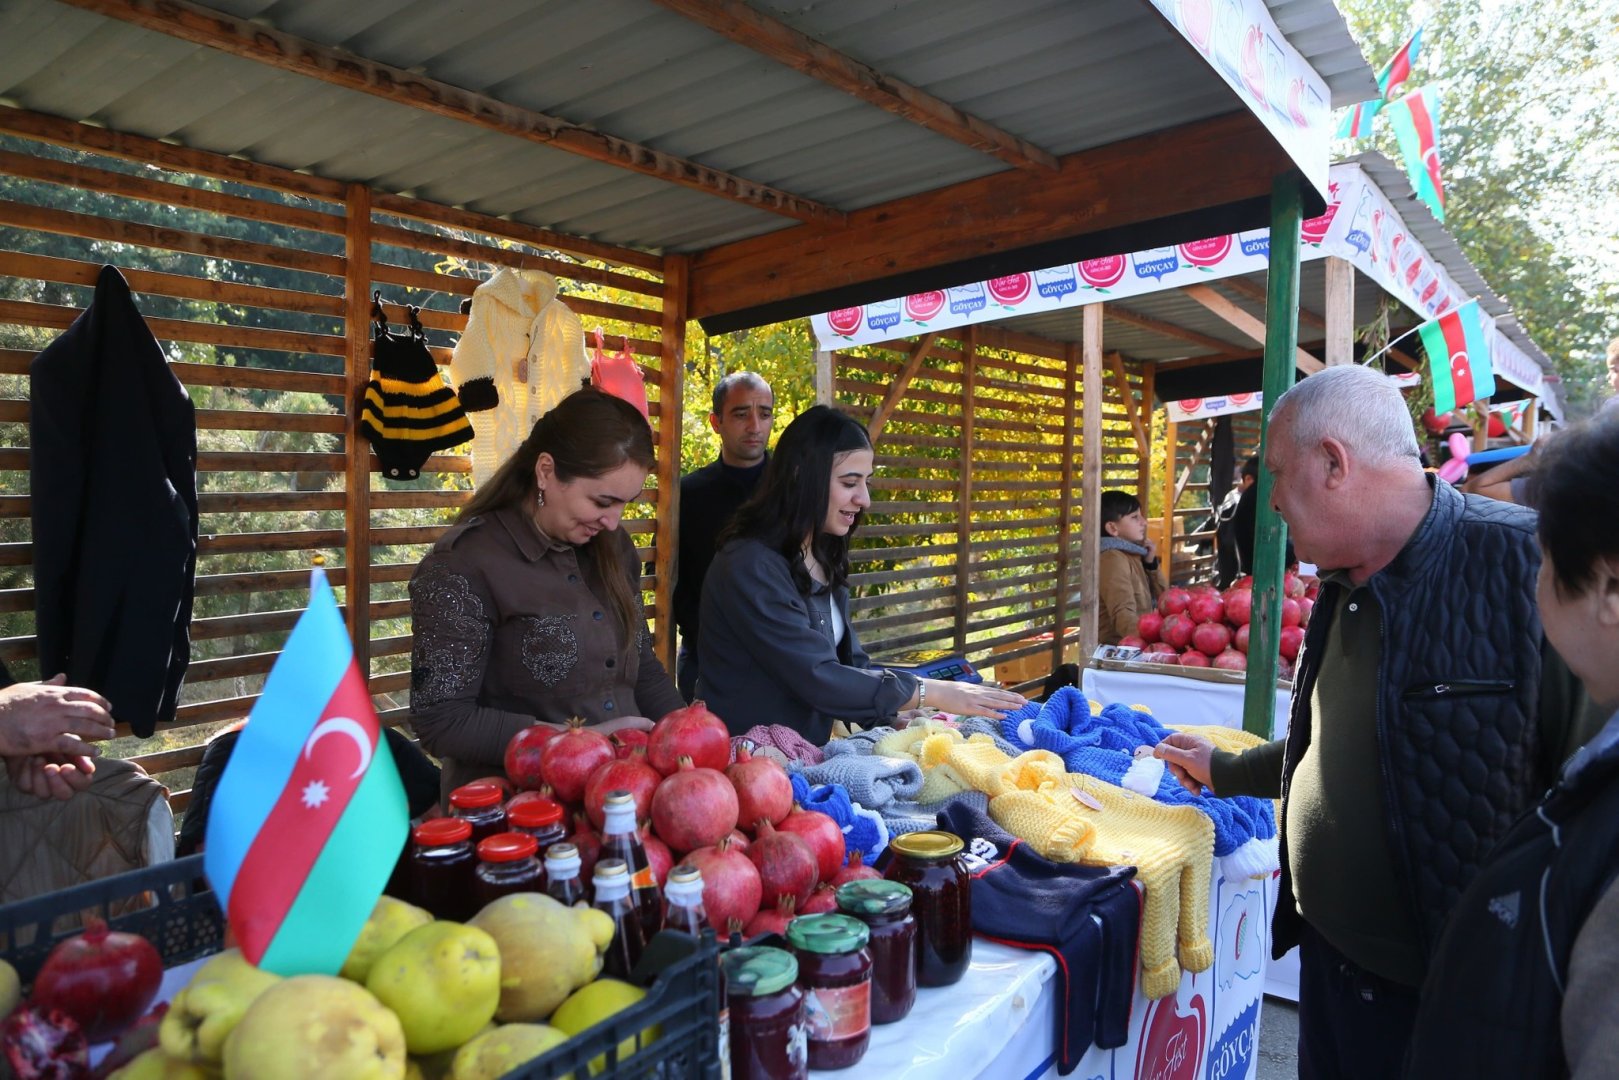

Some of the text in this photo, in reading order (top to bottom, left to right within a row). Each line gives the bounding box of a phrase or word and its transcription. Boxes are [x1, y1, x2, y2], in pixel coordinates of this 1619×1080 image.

[1138, 261, 1175, 275] GÖYÇAY
[1041, 282, 1074, 295] GÖYÇAY
[952, 301, 984, 312] GÖYÇAY
[869, 315, 898, 328] GÖYÇAY
